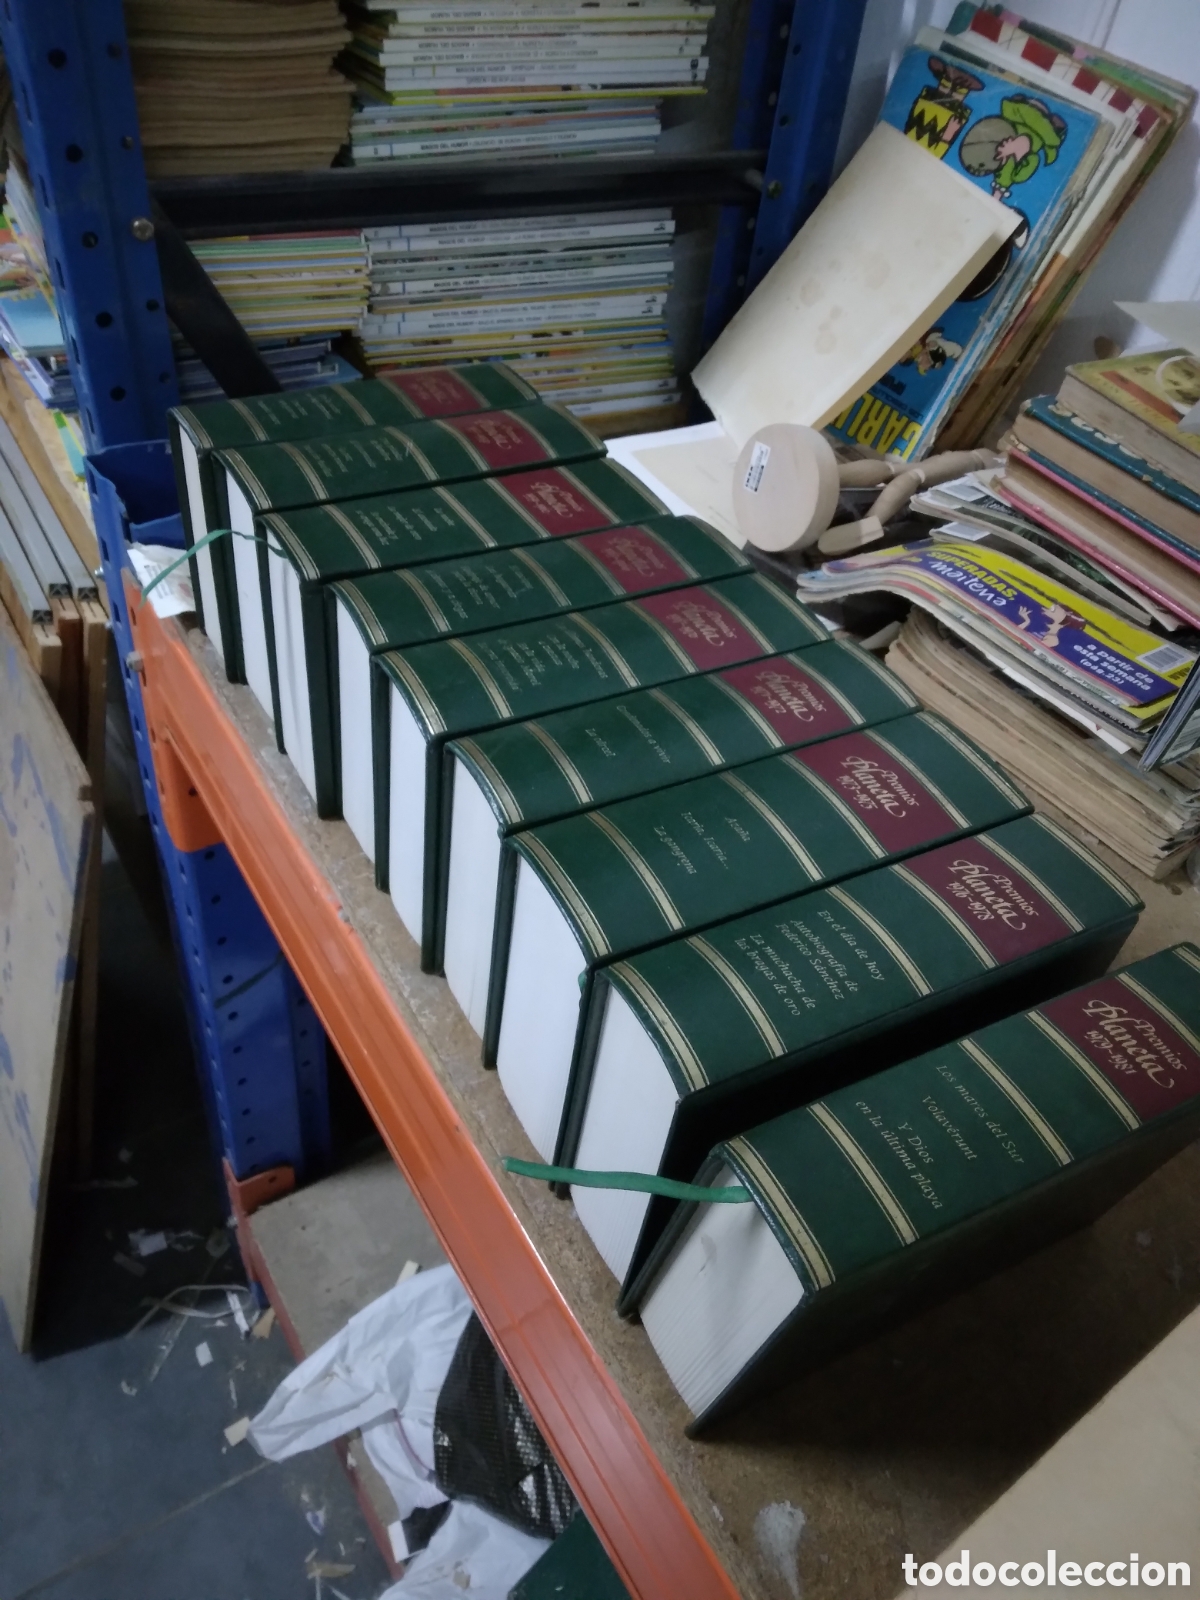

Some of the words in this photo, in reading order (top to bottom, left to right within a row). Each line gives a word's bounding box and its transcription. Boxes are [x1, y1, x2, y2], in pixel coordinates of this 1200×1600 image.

[928, 561, 1007, 606] maitena
[1073, 645, 1100, 662] esta
[1100, 661, 1151, 691] semana
[1096, 650, 1135, 672] partir
[1135, 672, 1154, 684] de
[754, 670, 815, 722] Planeta
[791, 681, 827, 712] Premios
[840, 755, 907, 818] Planeta
[881, 769, 920, 807] Premios
[653, 825, 667, 837] La
[660, 837, 697, 875] gangrena
[945, 881, 995, 920] 1976-1978
[947, 859, 1027, 931] Planeta
[992, 874, 1039, 917] Premios
[750, 933, 765, 946] La
[762, 946, 806, 994] muchacha
[801, 996, 816, 1009] de
[775, 923, 812, 957] Federico
[809, 958, 845, 1000] Sánchez
[790, 920, 848, 978] Autobiografía
[844, 980, 859, 992] de
[817, 909, 834, 923] En
[831, 922, 846, 932] el
[840, 930, 857, 947] día
[855, 945, 869, 959] de
[865, 960, 885, 981] hoy
[746, 950, 778, 981] bragas
[773, 982, 787, 995] de
[783, 997, 801, 1017] oro
[1082, 999, 1175, 1089] Planeta
[1084, 1030, 1138, 1075] 1979-1981
[1133, 1019, 1188, 1071] Premios
[921, 1095, 978, 1161] Volavérunt
[935, 1065, 957, 1083] Los
[954, 1084, 989, 1119] mares
[985, 1121, 1008, 1139] del
[1001, 1140, 1025, 1164] Sur
[855, 1100, 872, 1115] en
[868, 1115, 883, 1127] la
[880, 1130, 917, 1170] última
[910, 1172, 944, 1209] playa
[897, 1121, 913, 1132] Y
[907, 1135, 934, 1165] Dios
